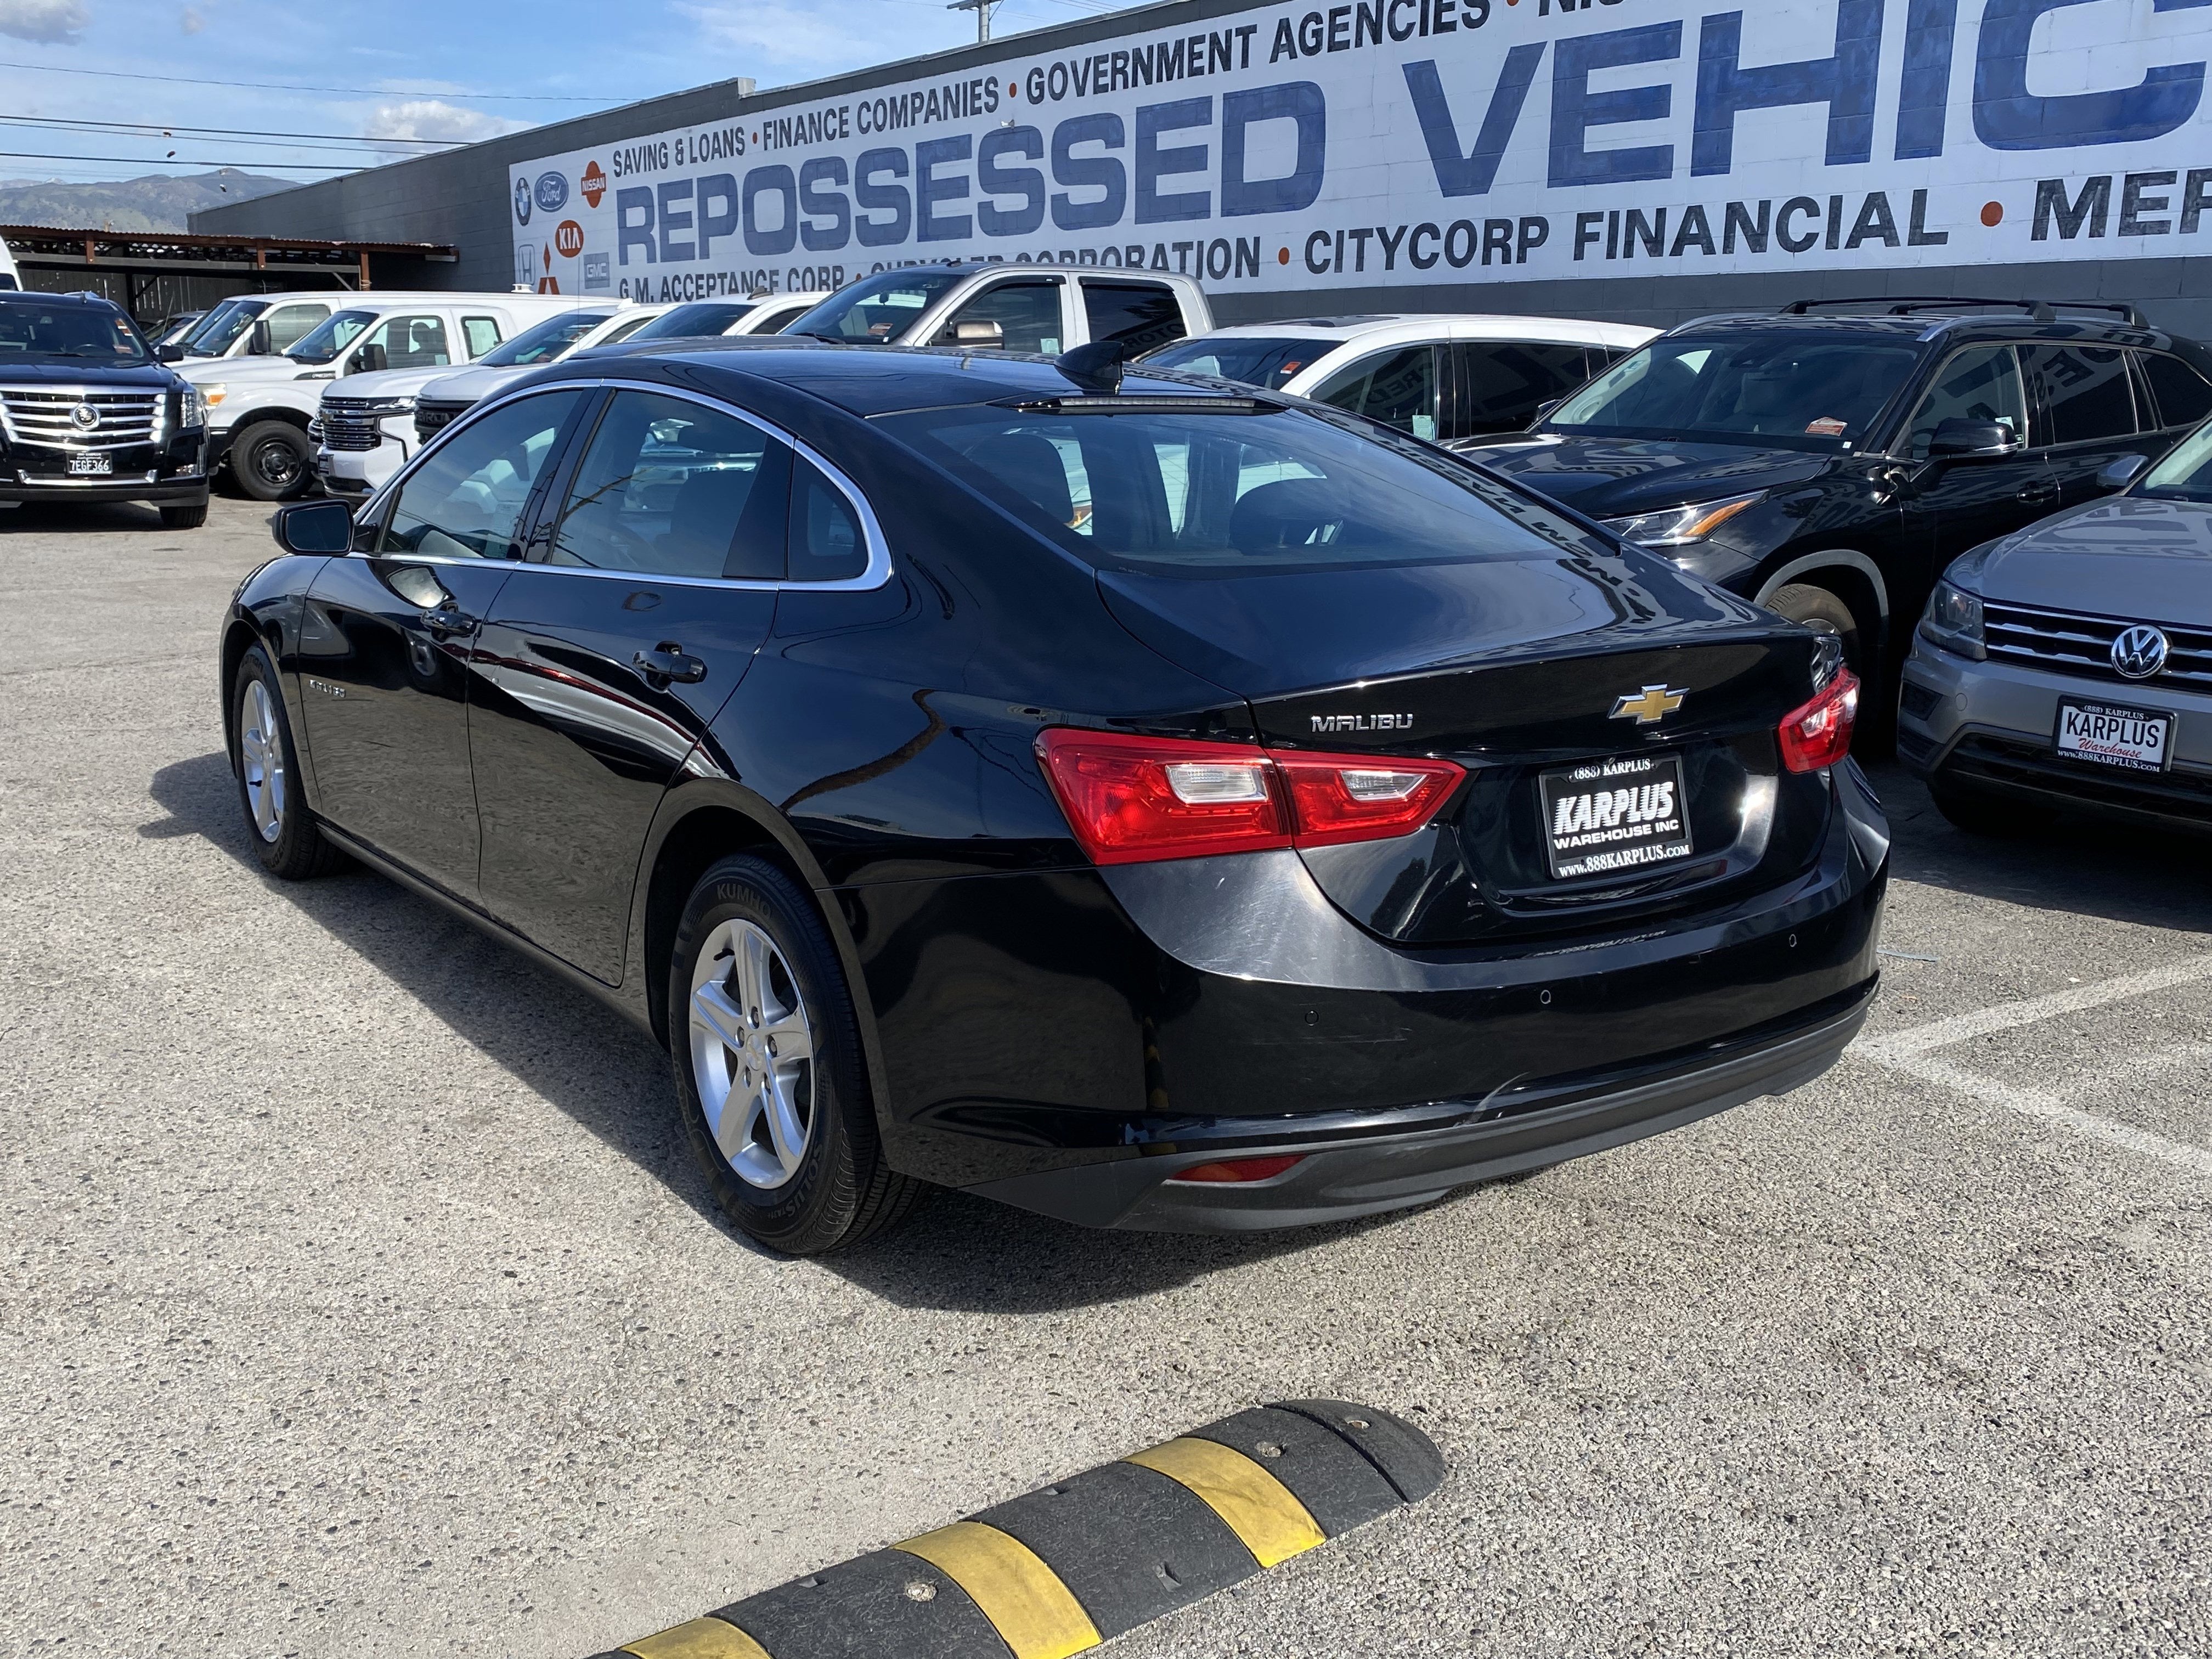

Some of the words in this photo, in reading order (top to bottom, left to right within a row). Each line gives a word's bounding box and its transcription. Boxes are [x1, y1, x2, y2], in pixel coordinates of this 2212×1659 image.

[613, 141, 668, 177] SAVING
[675, 138, 684, 165] &
[689, 126, 746, 162] LOANS
[763, 105, 849, 150] FINANCE
[856, 76, 999, 133] COMPANIES
[1026, 24, 1257, 105] GOVERNMENT
[1269, 0, 1490, 63] AGENCIES
[582, 176, 605, 193] NISSAN
[616, 81, 1327, 266] REPOSSESSED
[541, 180, 561, 203] Ford
[558, 227, 581, 250] KIA
[660, 269, 780, 302] ACCEPTANCE
[1015, 236, 1261, 280] ORATION
[1304, 216, 1549, 274] CITYCORP
[1573, 189, 1949, 261] FINANCIAL
[586, 262, 607, 278] GMC
[69, 460, 110, 471] 7EGF366
[1311, 714, 1413, 732] MALIBU
[2084, 704, 2103, 714] (888)
[2105, 708, 2145, 720] KARPLUS
[2066, 712, 2160, 748] KARPLUS
[2078, 737, 2142, 759] Warehouse
[1574, 765, 1600, 780] (888)
[1602, 758, 1651, 776] KARPLUS
[1553, 781, 1674, 835] KARPLUS
[1553, 824, 1652, 850] WAREHOUSE
[1655, 819, 1679, 833] INC
[716, 883, 771, 921] KUMHO
